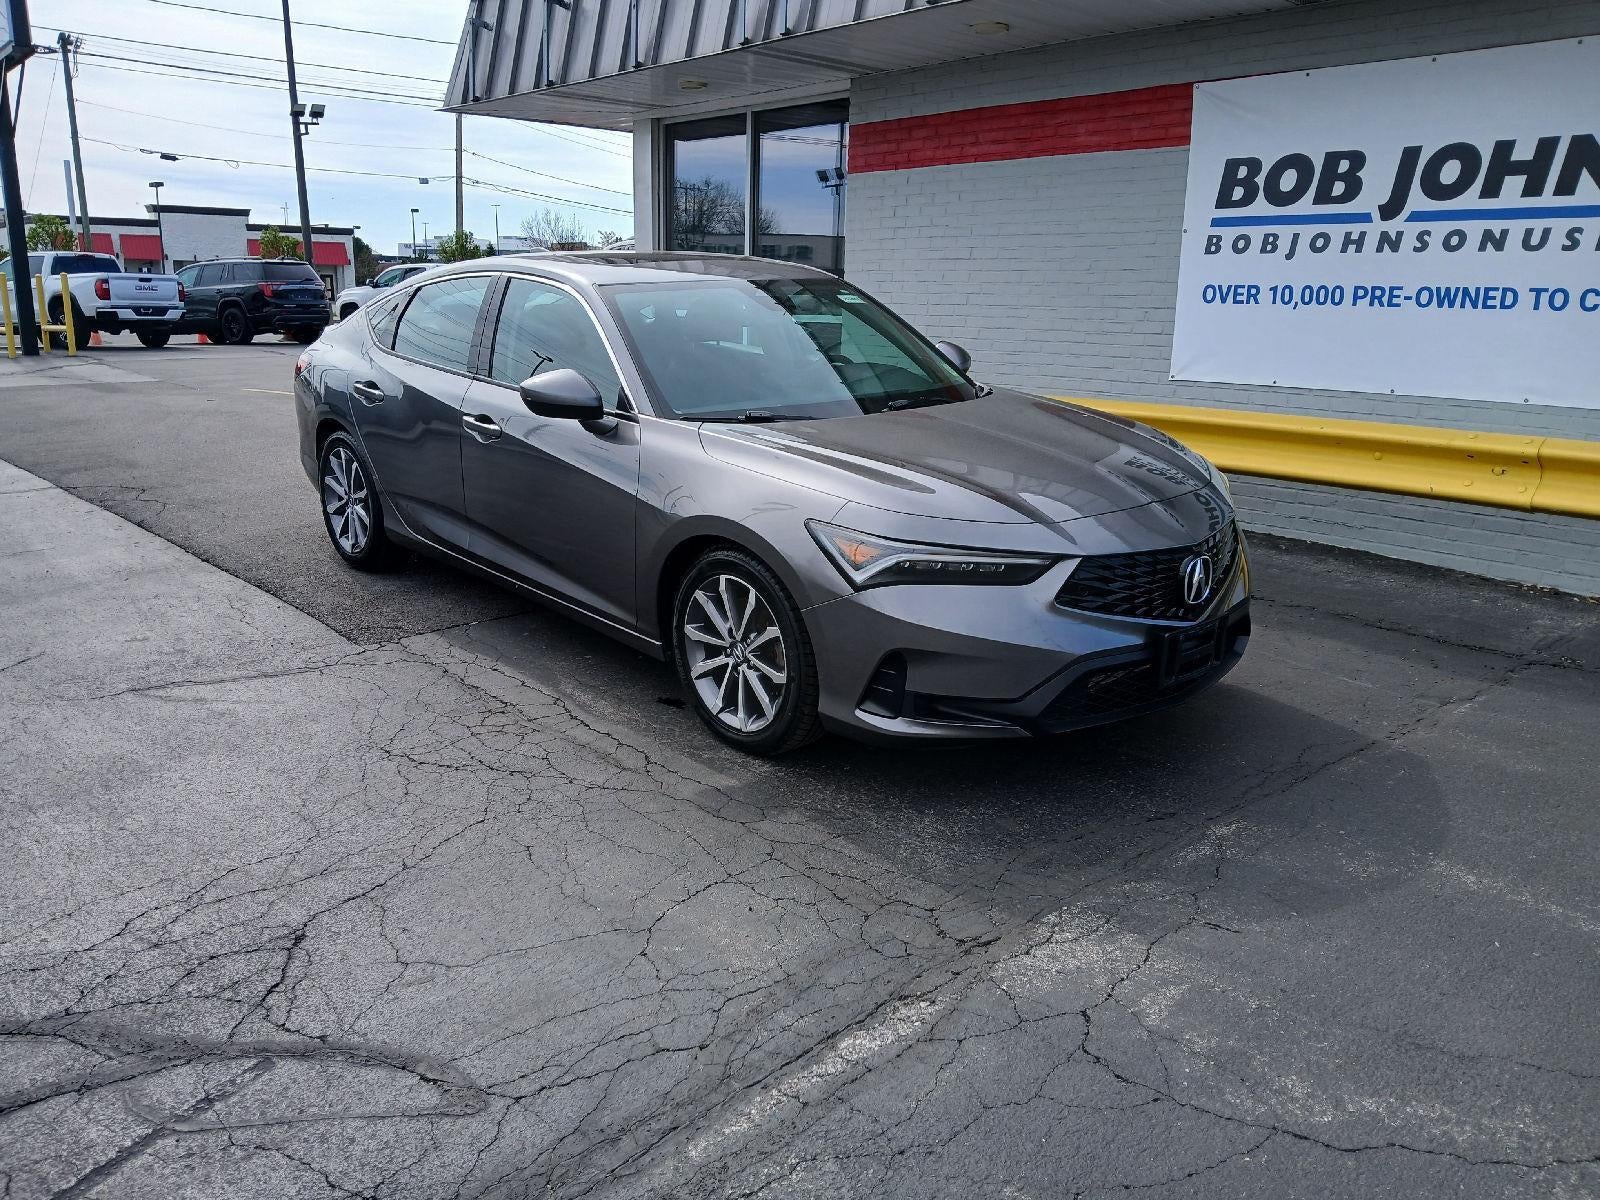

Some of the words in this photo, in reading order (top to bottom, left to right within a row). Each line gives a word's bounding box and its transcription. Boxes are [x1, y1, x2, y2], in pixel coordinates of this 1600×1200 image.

[1214, 149, 1367, 210] BOB
[1203, 226, 1600, 261] BOBJOHNSONUS
[1202, 283, 1261, 305] OVER
[1268, 284, 1345, 310] 10,000
[1351, 285, 1519, 310] PRE-OWNED
[1528, 287, 1571, 312] TO
